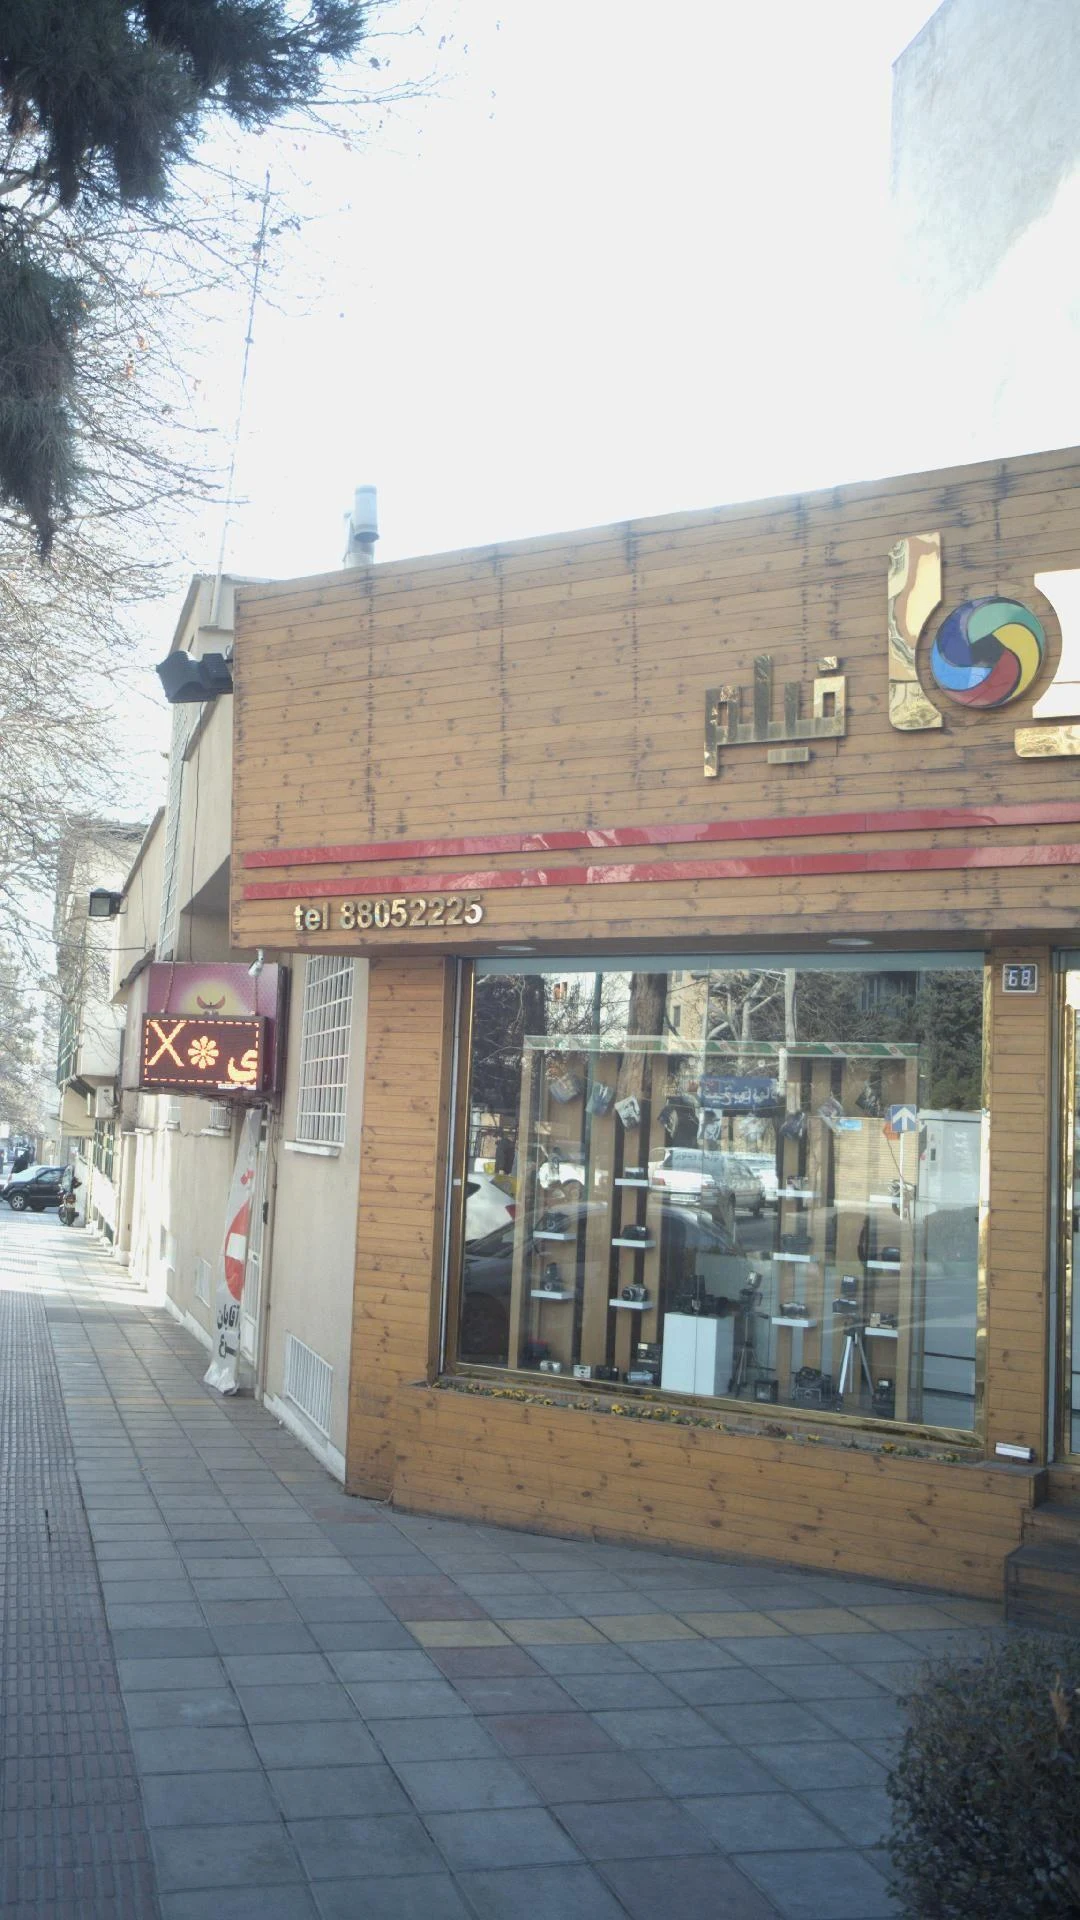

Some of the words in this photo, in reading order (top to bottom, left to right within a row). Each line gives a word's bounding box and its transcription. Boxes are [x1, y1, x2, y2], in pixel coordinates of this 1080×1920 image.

[704, 655, 847, 777] فیلم
[294, 904, 330, 931] tel
[340, 895, 484, 930] 88052225
[1009, 969, 1031, 986] 68
